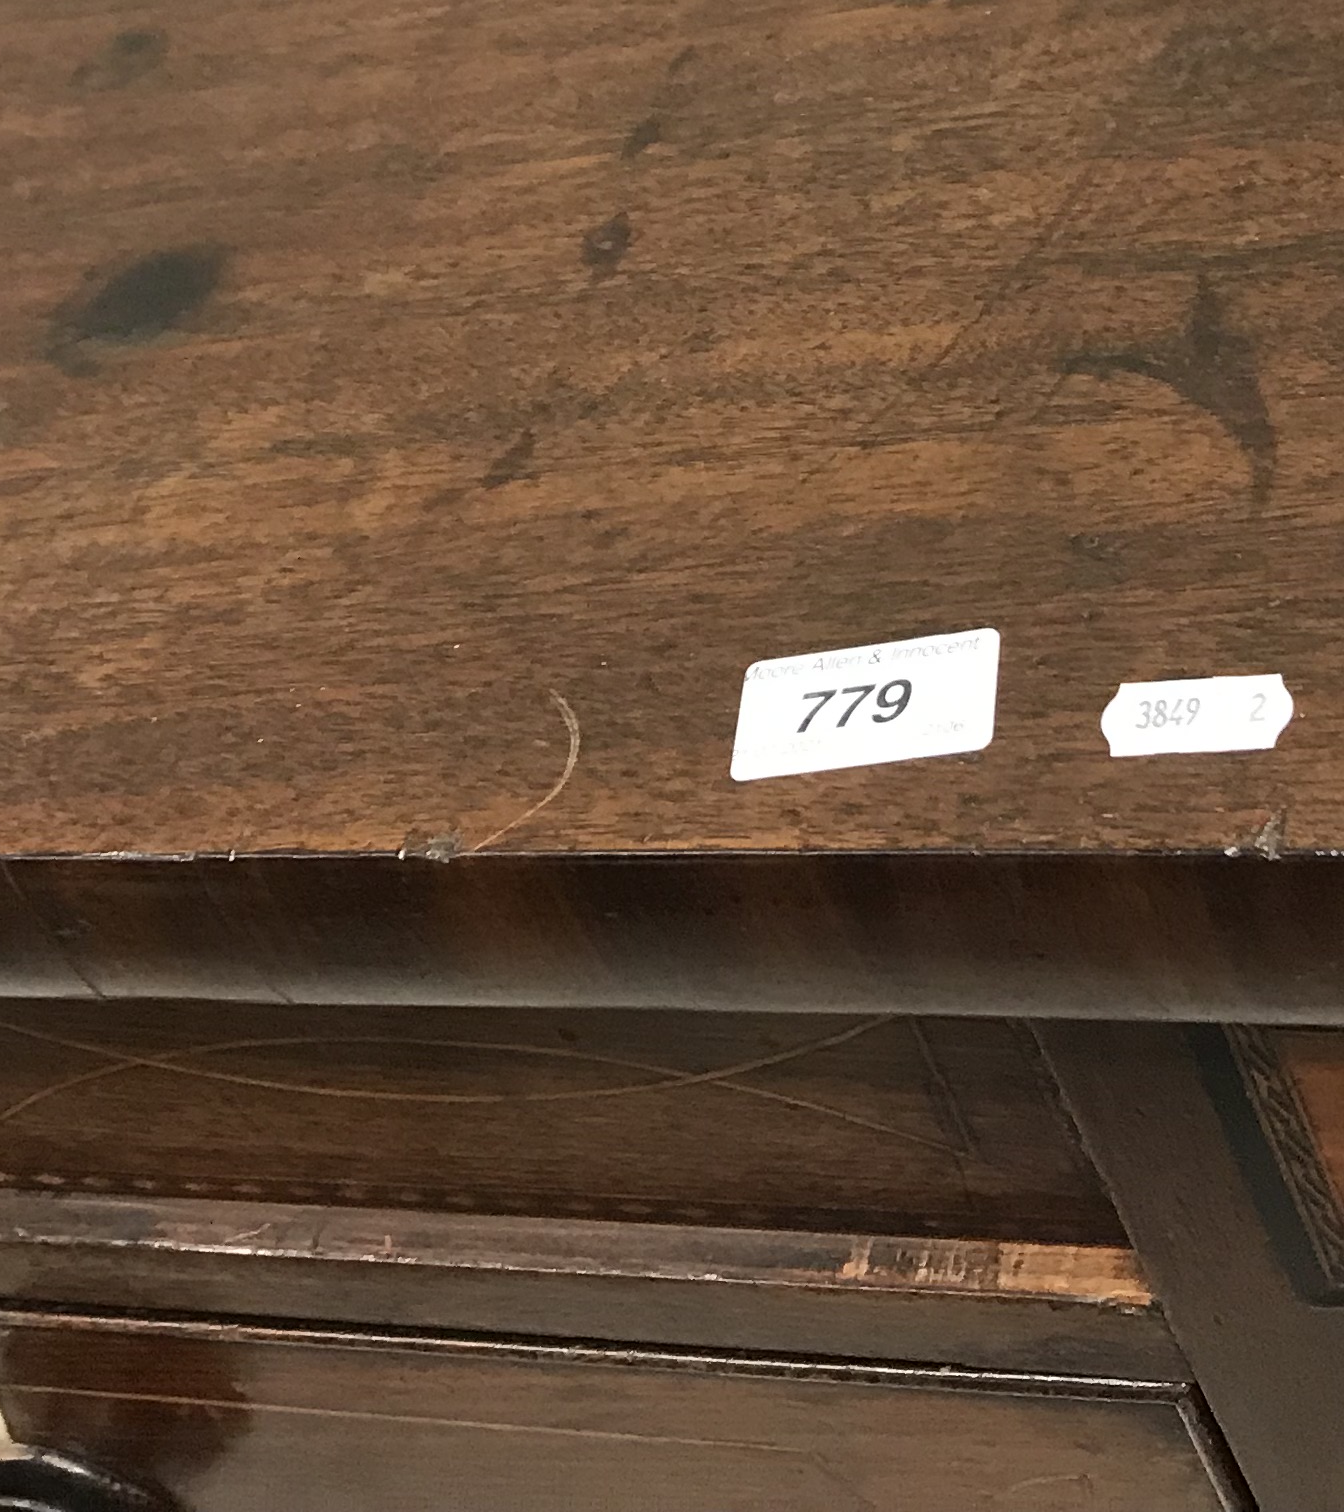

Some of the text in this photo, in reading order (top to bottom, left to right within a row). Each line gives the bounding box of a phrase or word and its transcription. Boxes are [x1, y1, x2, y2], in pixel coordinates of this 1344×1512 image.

[867, 648, 882, 665] &
[796, 678, 913, 734] 779
[1135, 692, 1268, 730] 3849 2
